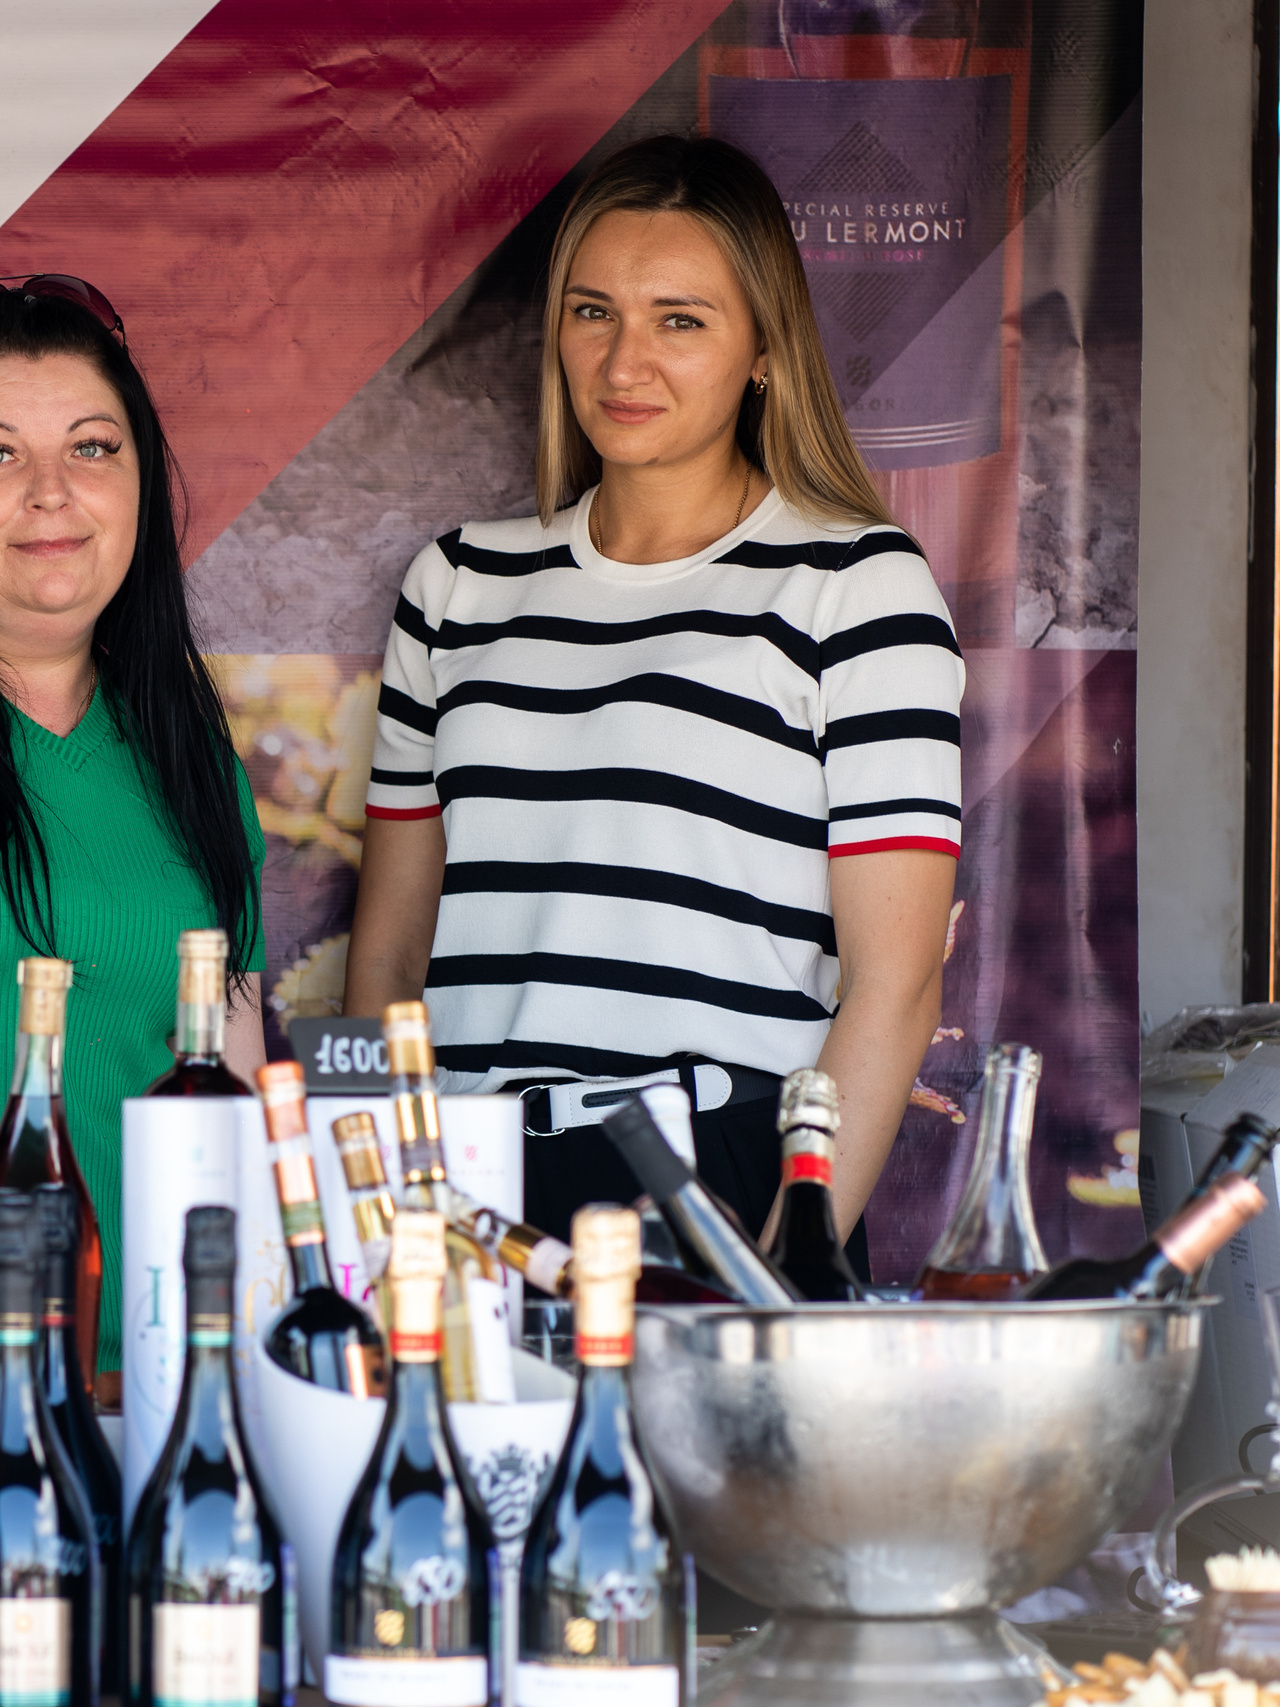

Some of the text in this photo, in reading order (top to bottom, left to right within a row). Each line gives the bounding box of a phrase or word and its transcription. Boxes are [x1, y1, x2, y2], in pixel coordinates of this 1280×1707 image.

[782, 201, 948, 217] PECIAL RESERVE
[826, 218, 966, 244] LERMONT
